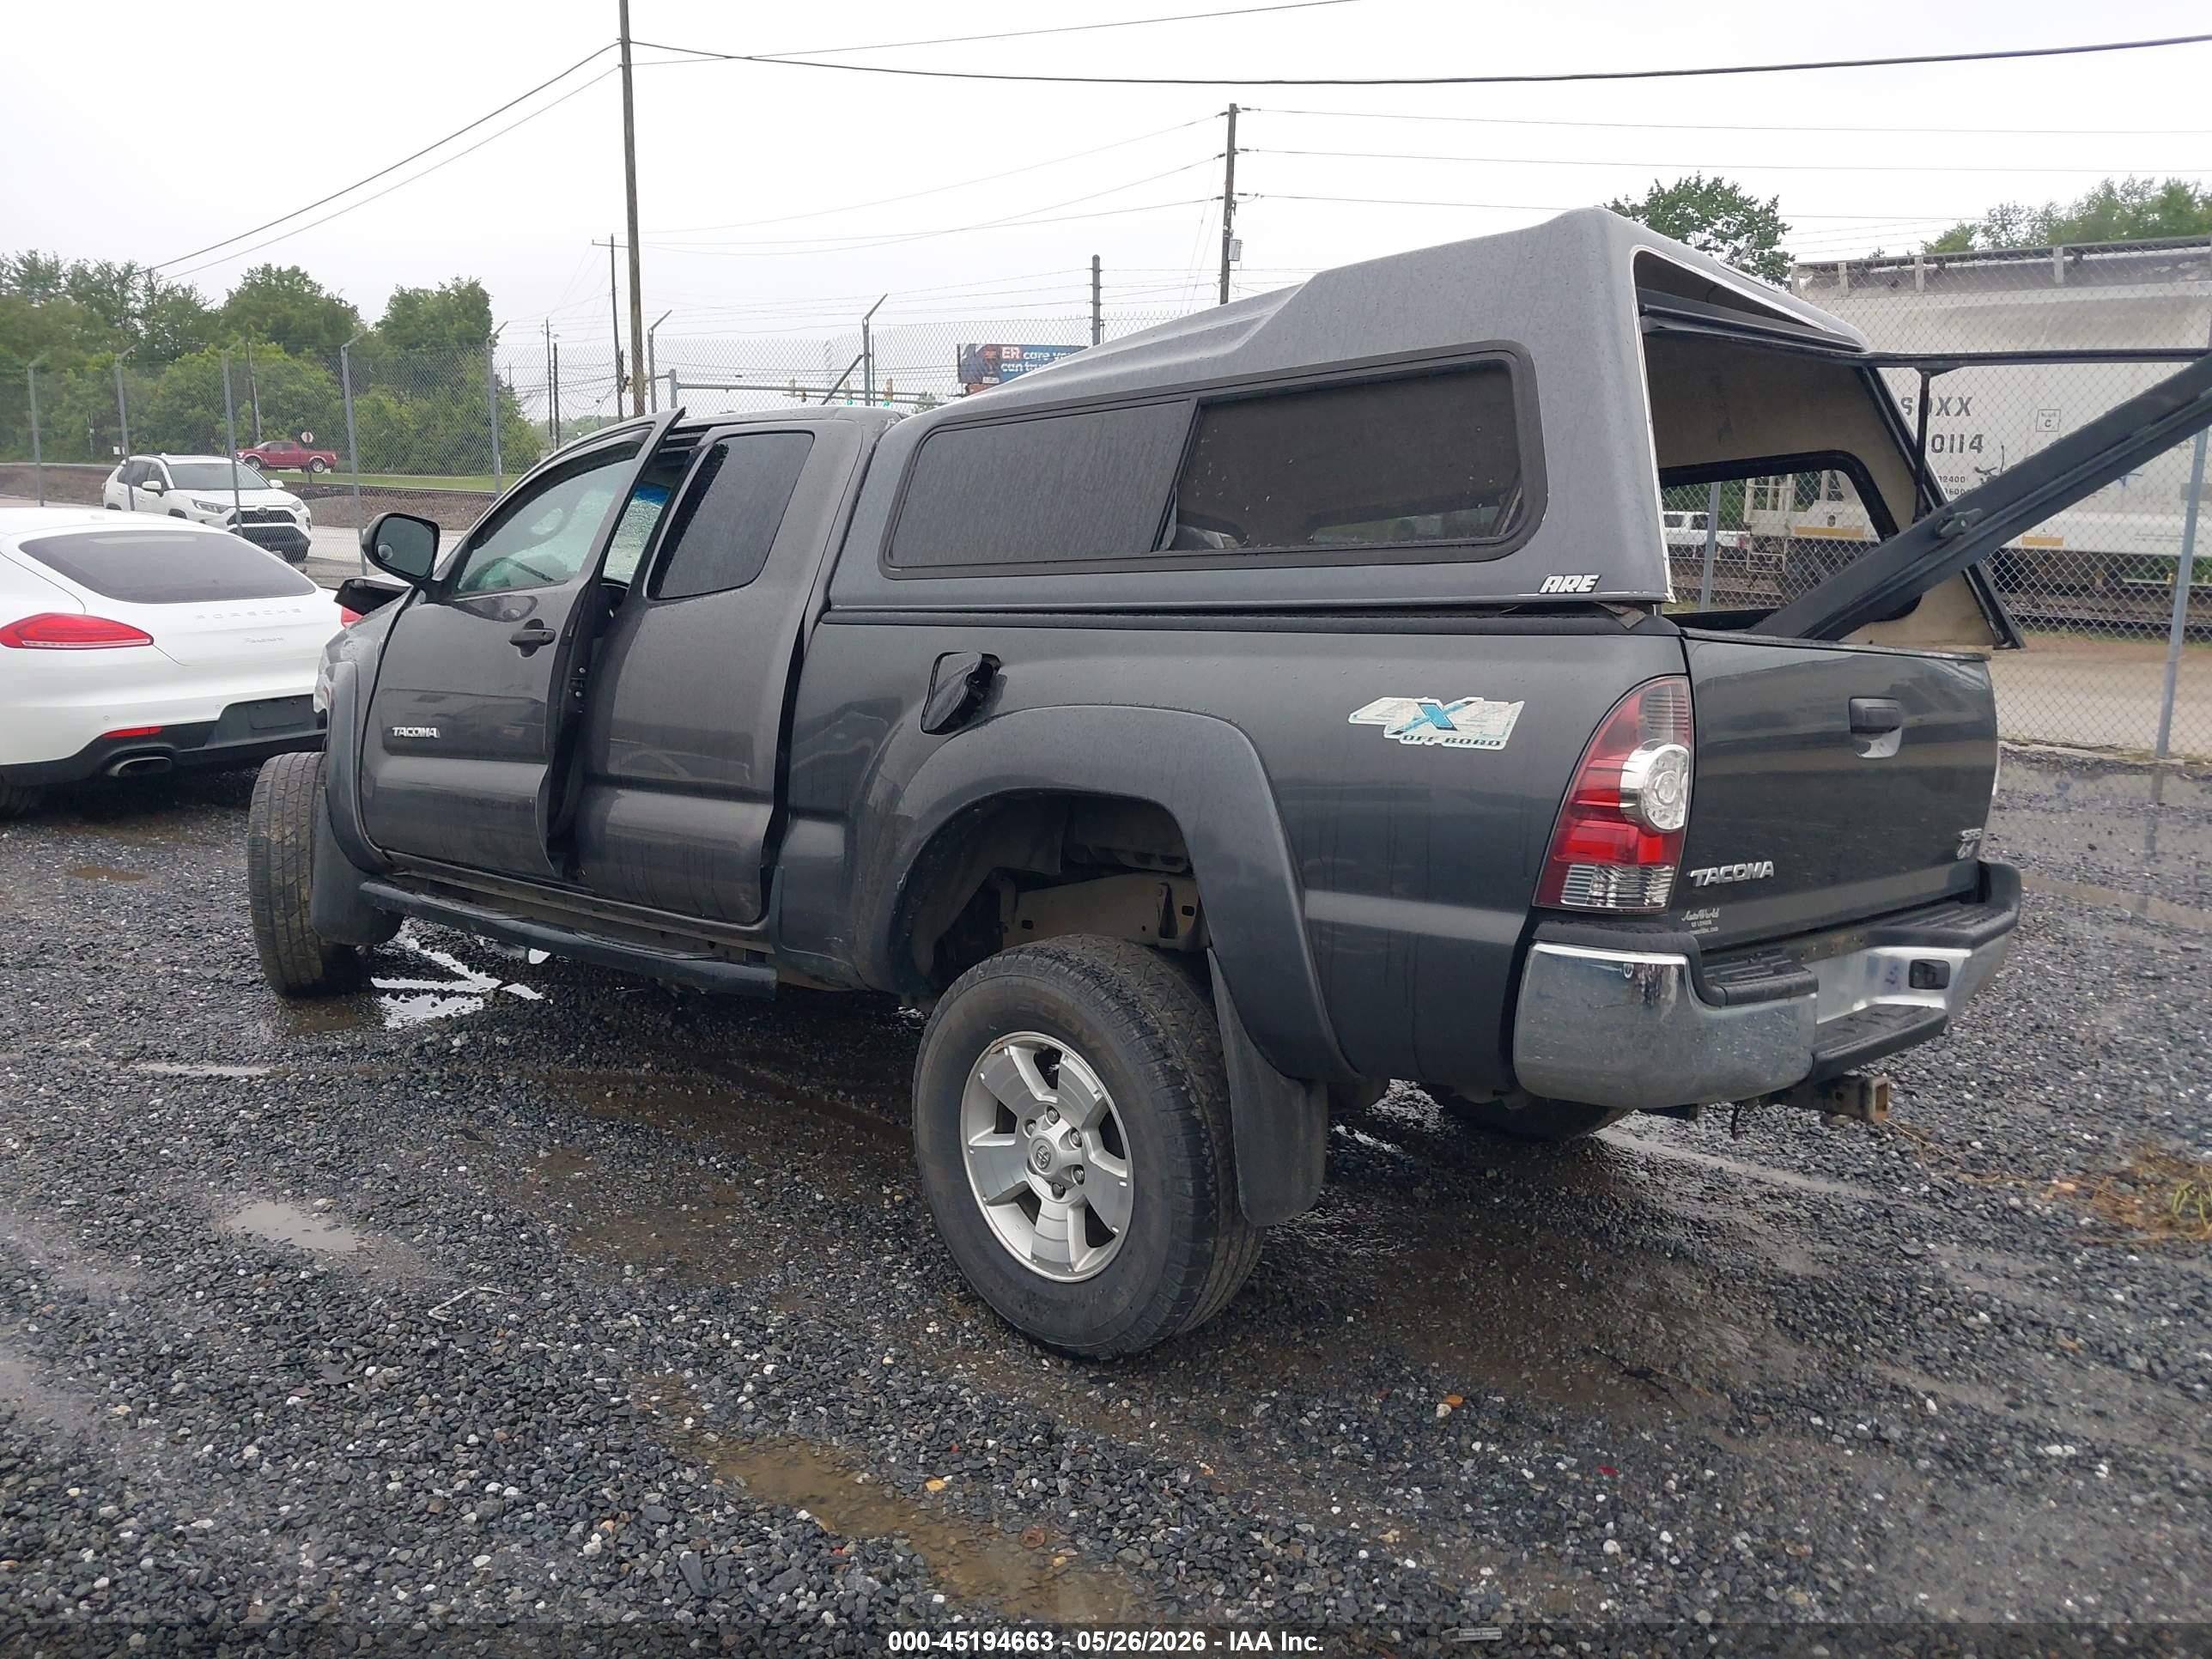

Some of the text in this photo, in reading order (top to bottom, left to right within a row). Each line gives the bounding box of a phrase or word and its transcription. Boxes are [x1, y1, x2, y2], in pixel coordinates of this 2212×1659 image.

[1001, 346, 1020, 359] ER
[1000, 363, 1023, 372] can
[1538, 574, 1601, 593] ARE
[392, 726, 441, 738] TACOMA
[1402, 734, 1502, 748] OFF ROAD
[1686, 860, 1775, 887] TACOMA
